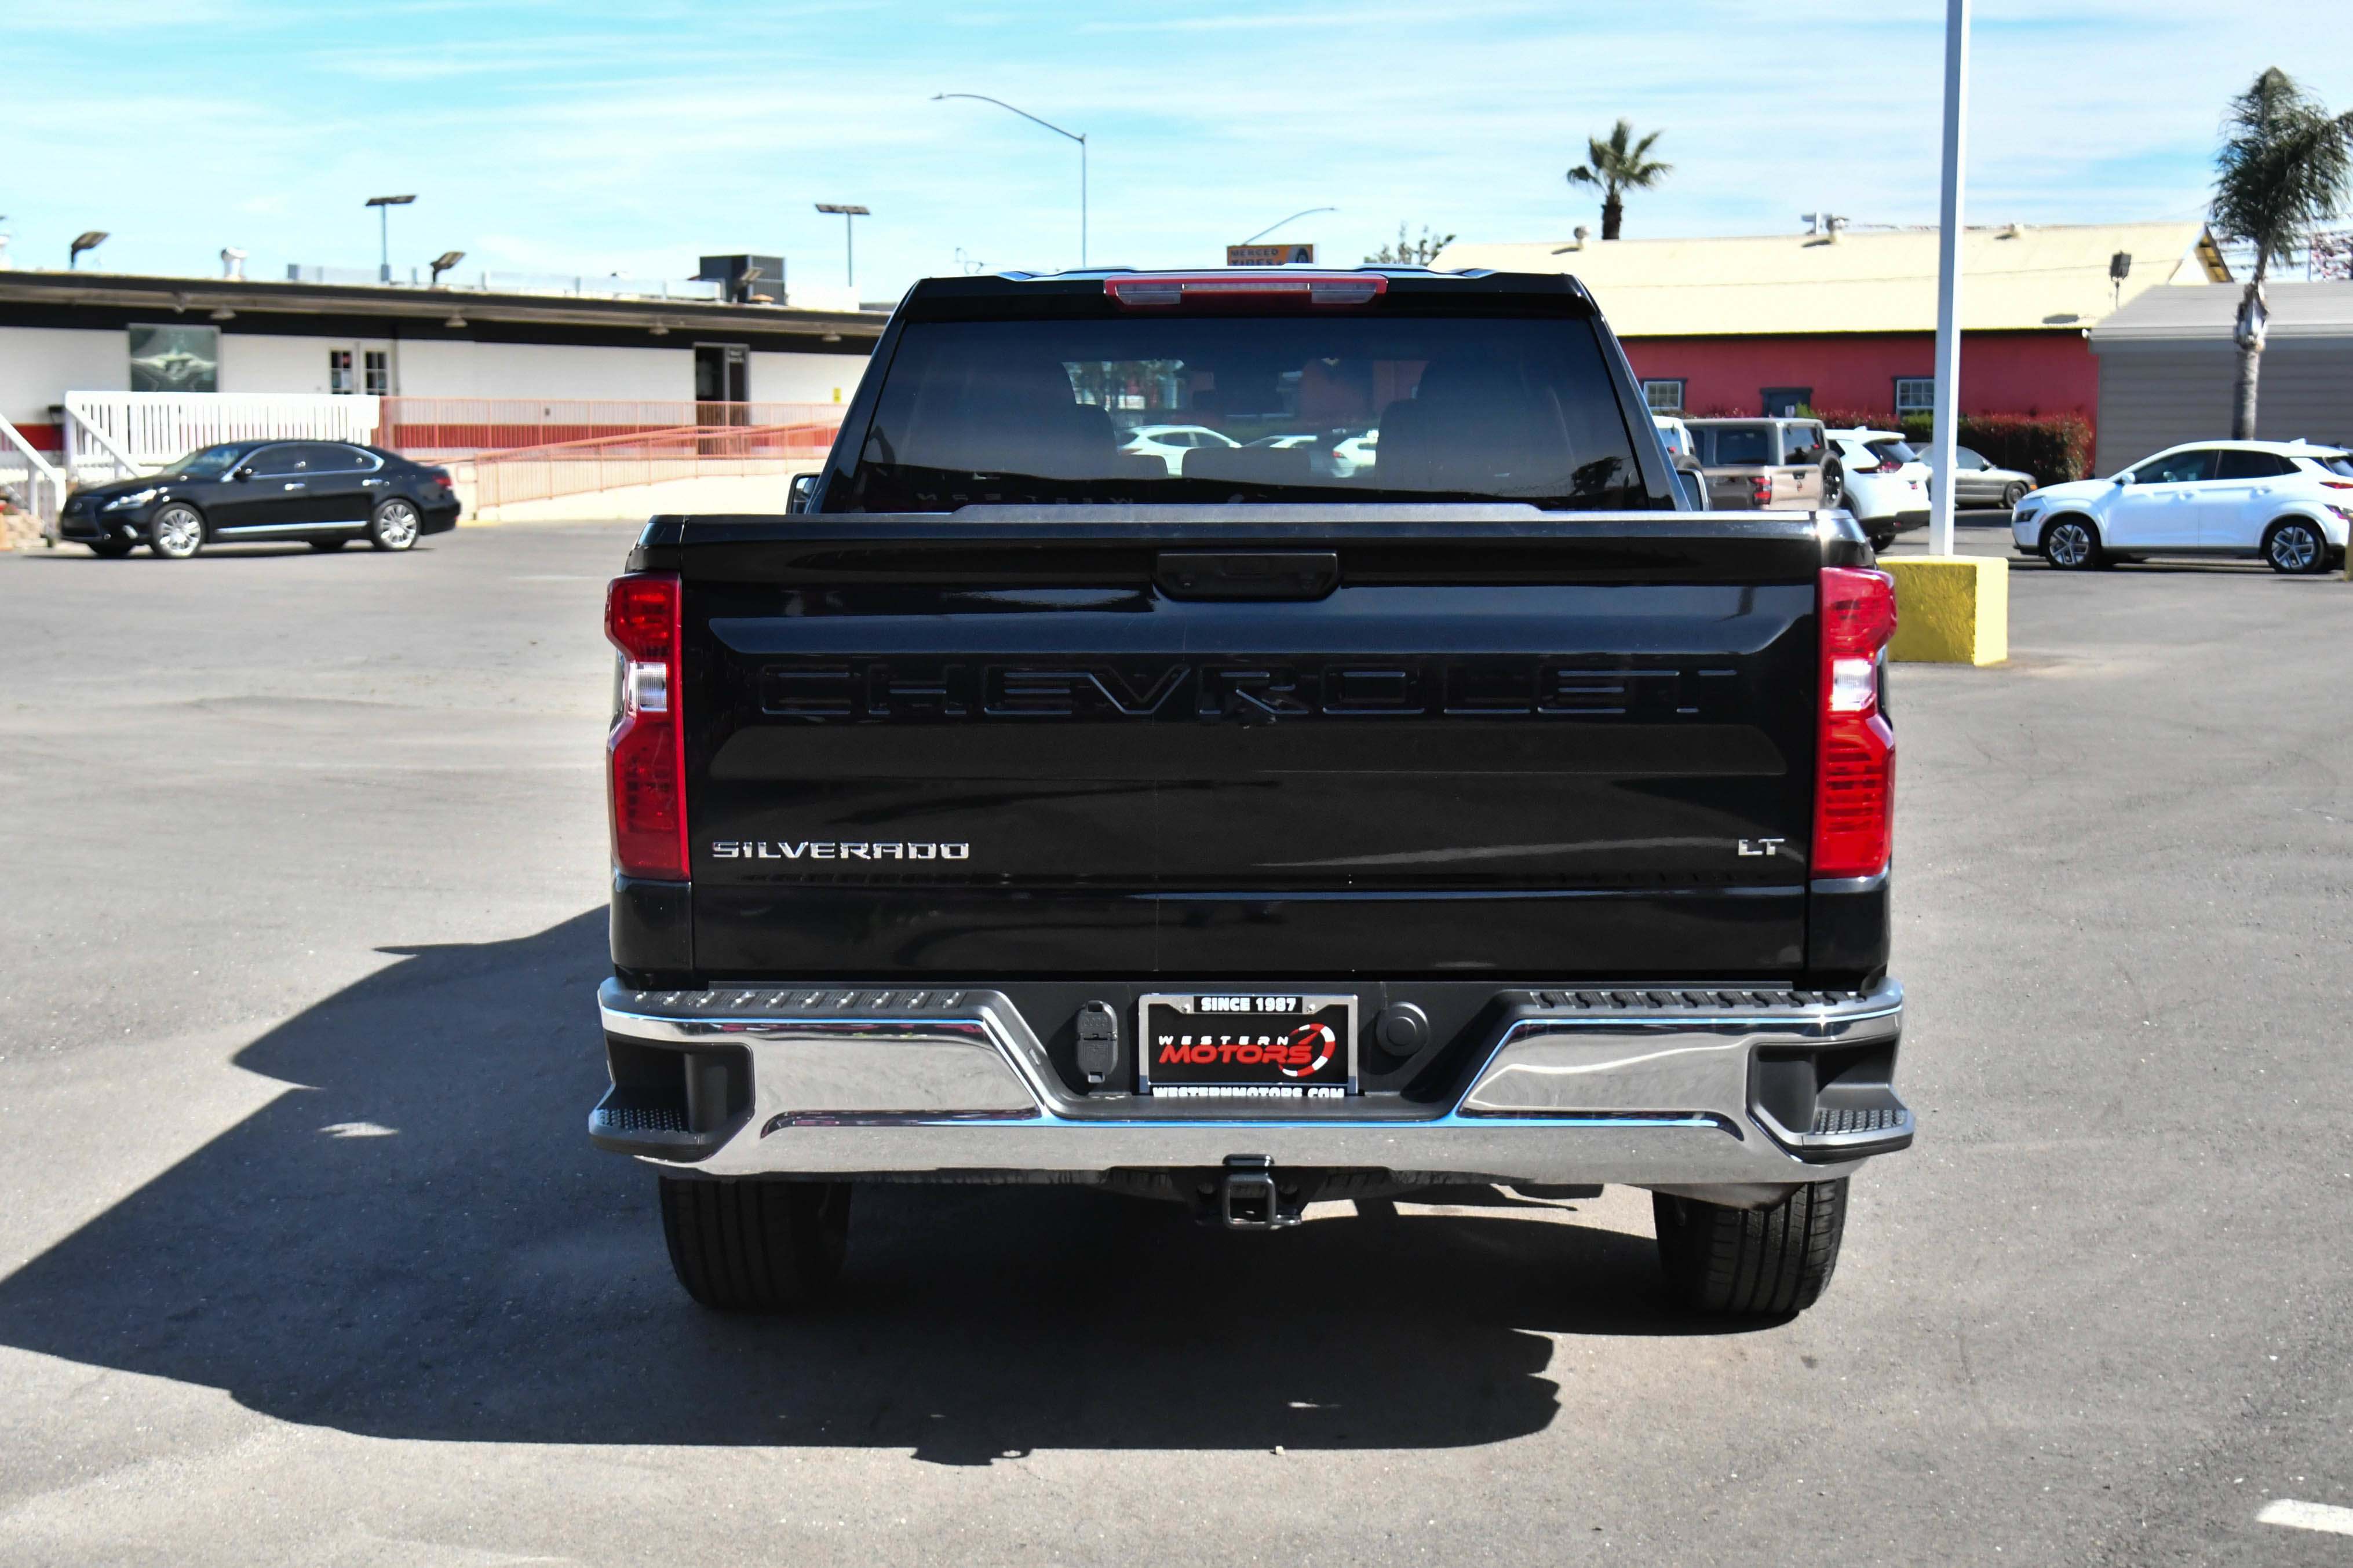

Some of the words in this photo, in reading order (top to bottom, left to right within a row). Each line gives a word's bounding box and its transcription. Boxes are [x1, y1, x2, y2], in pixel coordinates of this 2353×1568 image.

[1231, 248, 1279, 257] MERCED
[759, 663, 1738, 716] CHEVROLET
[712, 841, 969, 860] SILVERADO
[1738, 838, 1786, 856] LT
[1201, 997, 1250, 1011] SINCE
[1256, 997, 1297, 1011] 1987
[1158, 1035, 1289, 1045] WESTERN
[1159, 1044, 1312, 1064] MOTORS
[1152, 1087, 1345, 1098] WESTERNMOTORSCOM
